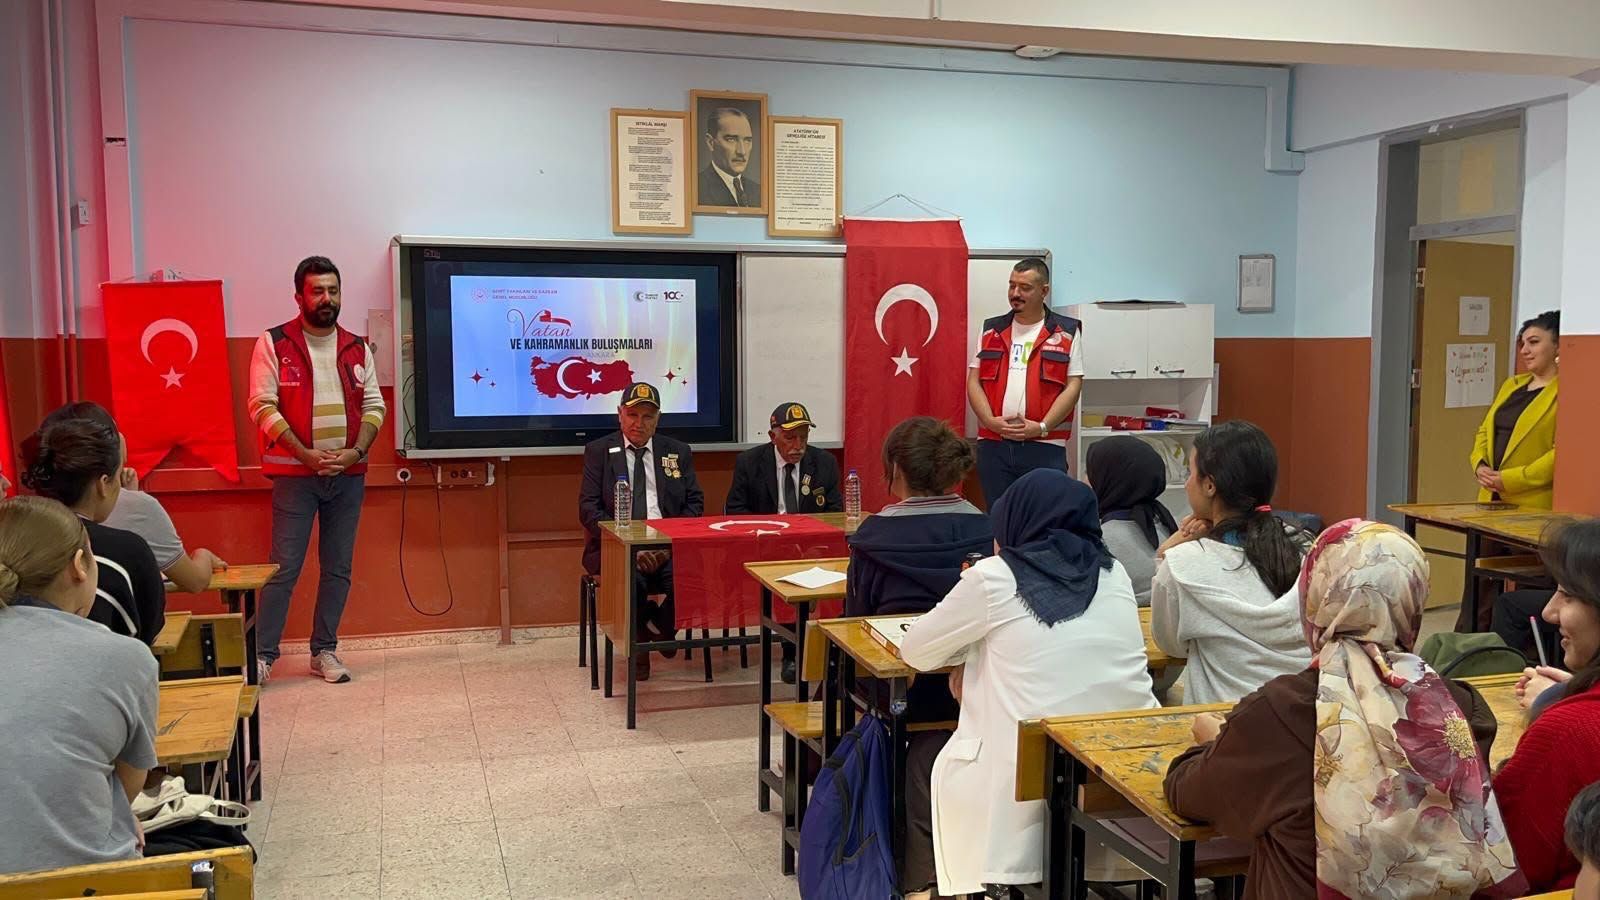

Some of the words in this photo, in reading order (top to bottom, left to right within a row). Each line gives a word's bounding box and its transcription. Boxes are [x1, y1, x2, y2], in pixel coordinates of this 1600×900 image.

[507, 309, 572, 338] Vatan
[510, 339, 522, 350] VE
[525, 339, 589, 350] KAHRAMANLIK
[592, 339, 653, 353] BULUŞMALARI
